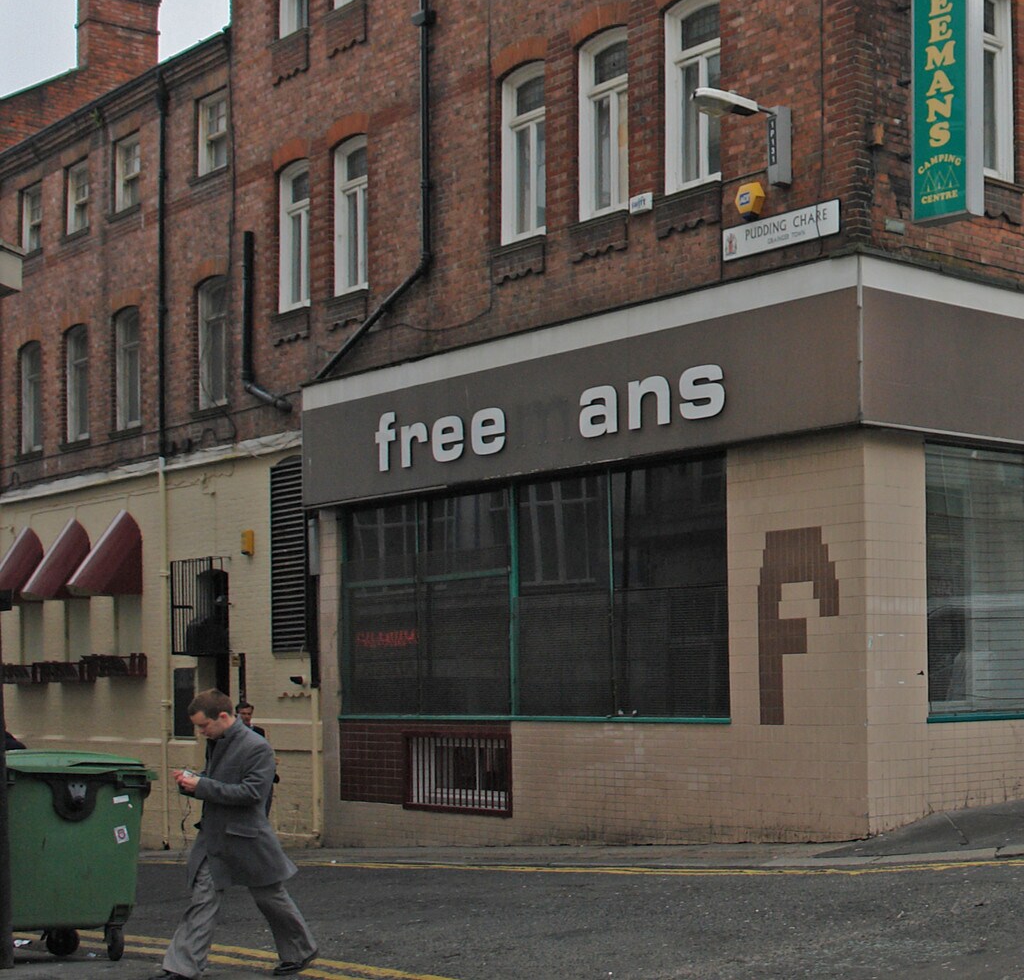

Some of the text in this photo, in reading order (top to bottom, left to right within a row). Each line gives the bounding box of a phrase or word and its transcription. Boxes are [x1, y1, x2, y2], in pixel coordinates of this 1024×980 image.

[918, 153, 962, 174] CAMPING
[921, 189, 958, 204] CENTRE
[745, 208, 828, 241] PUDDING CHARE
